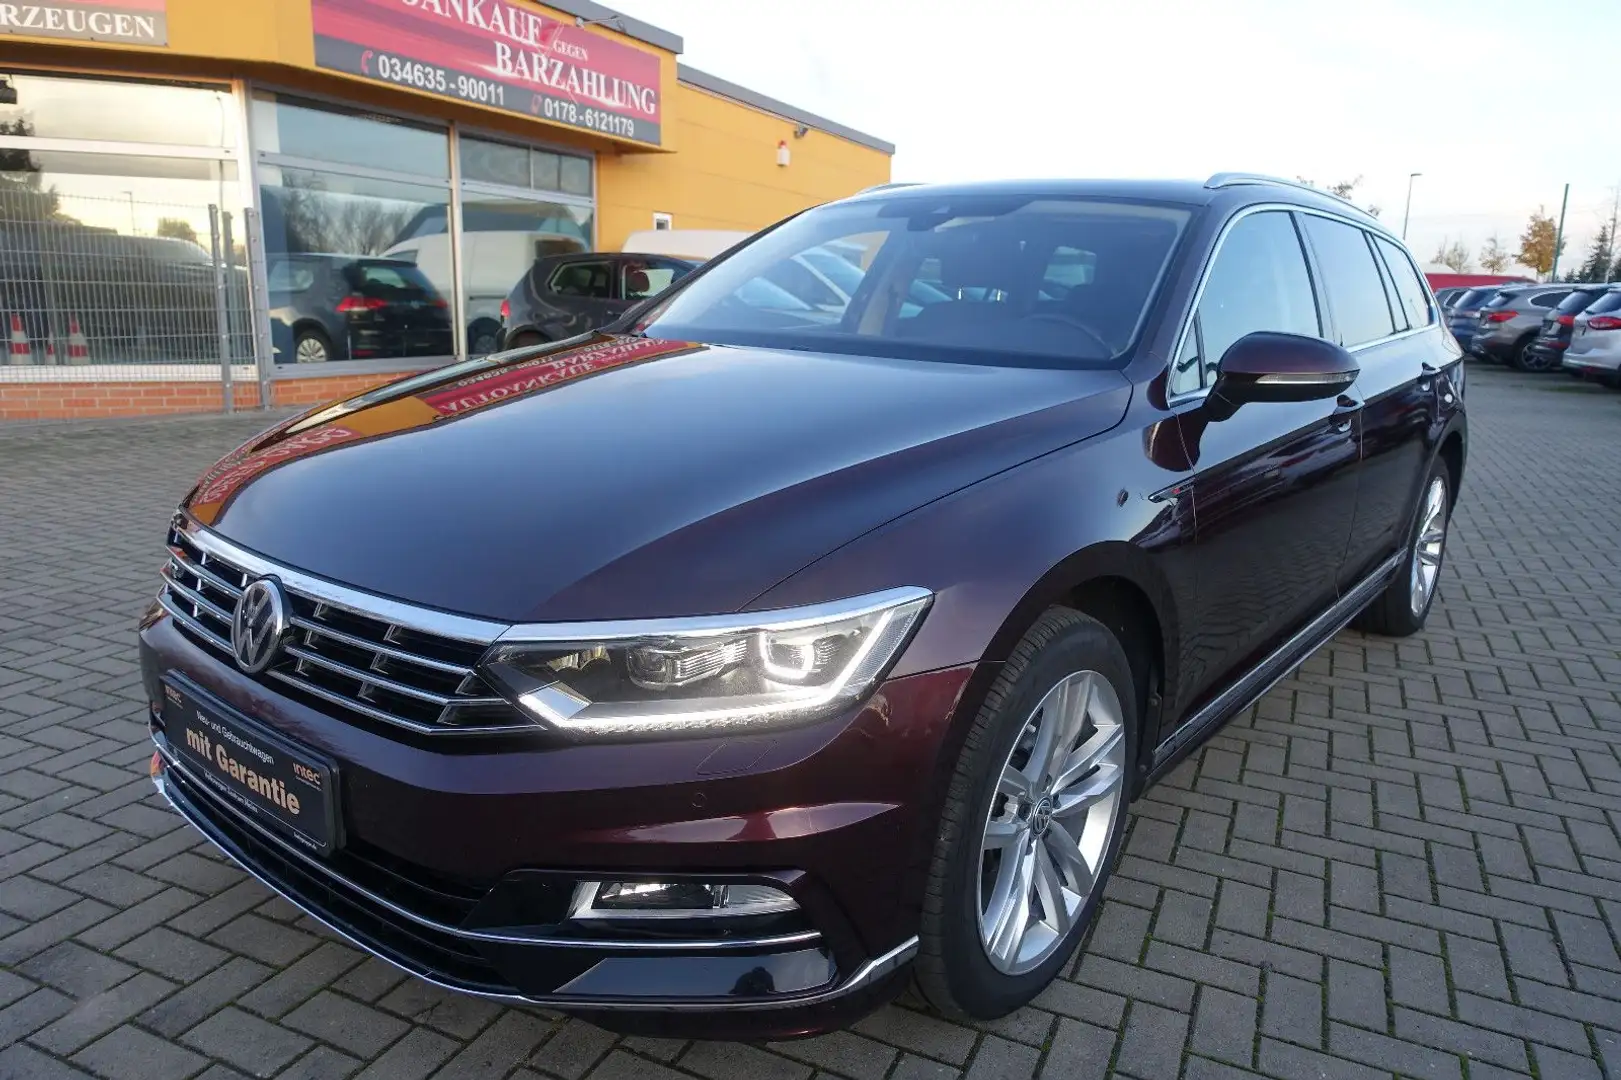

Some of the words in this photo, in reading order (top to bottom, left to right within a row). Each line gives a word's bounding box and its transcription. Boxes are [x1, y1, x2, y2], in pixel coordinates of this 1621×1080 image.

[554, 40, 589, 61] GEGEN
[494, 41, 656, 115] BARZAHLUNG
[210, 721, 222, 734] und
[221, 725, 275, 765] Gebrauchtwagen
[186, 727, 213, 761] mit
[215, 743, 300, 815] Garantie
[292, 762, 321, 785] intec
